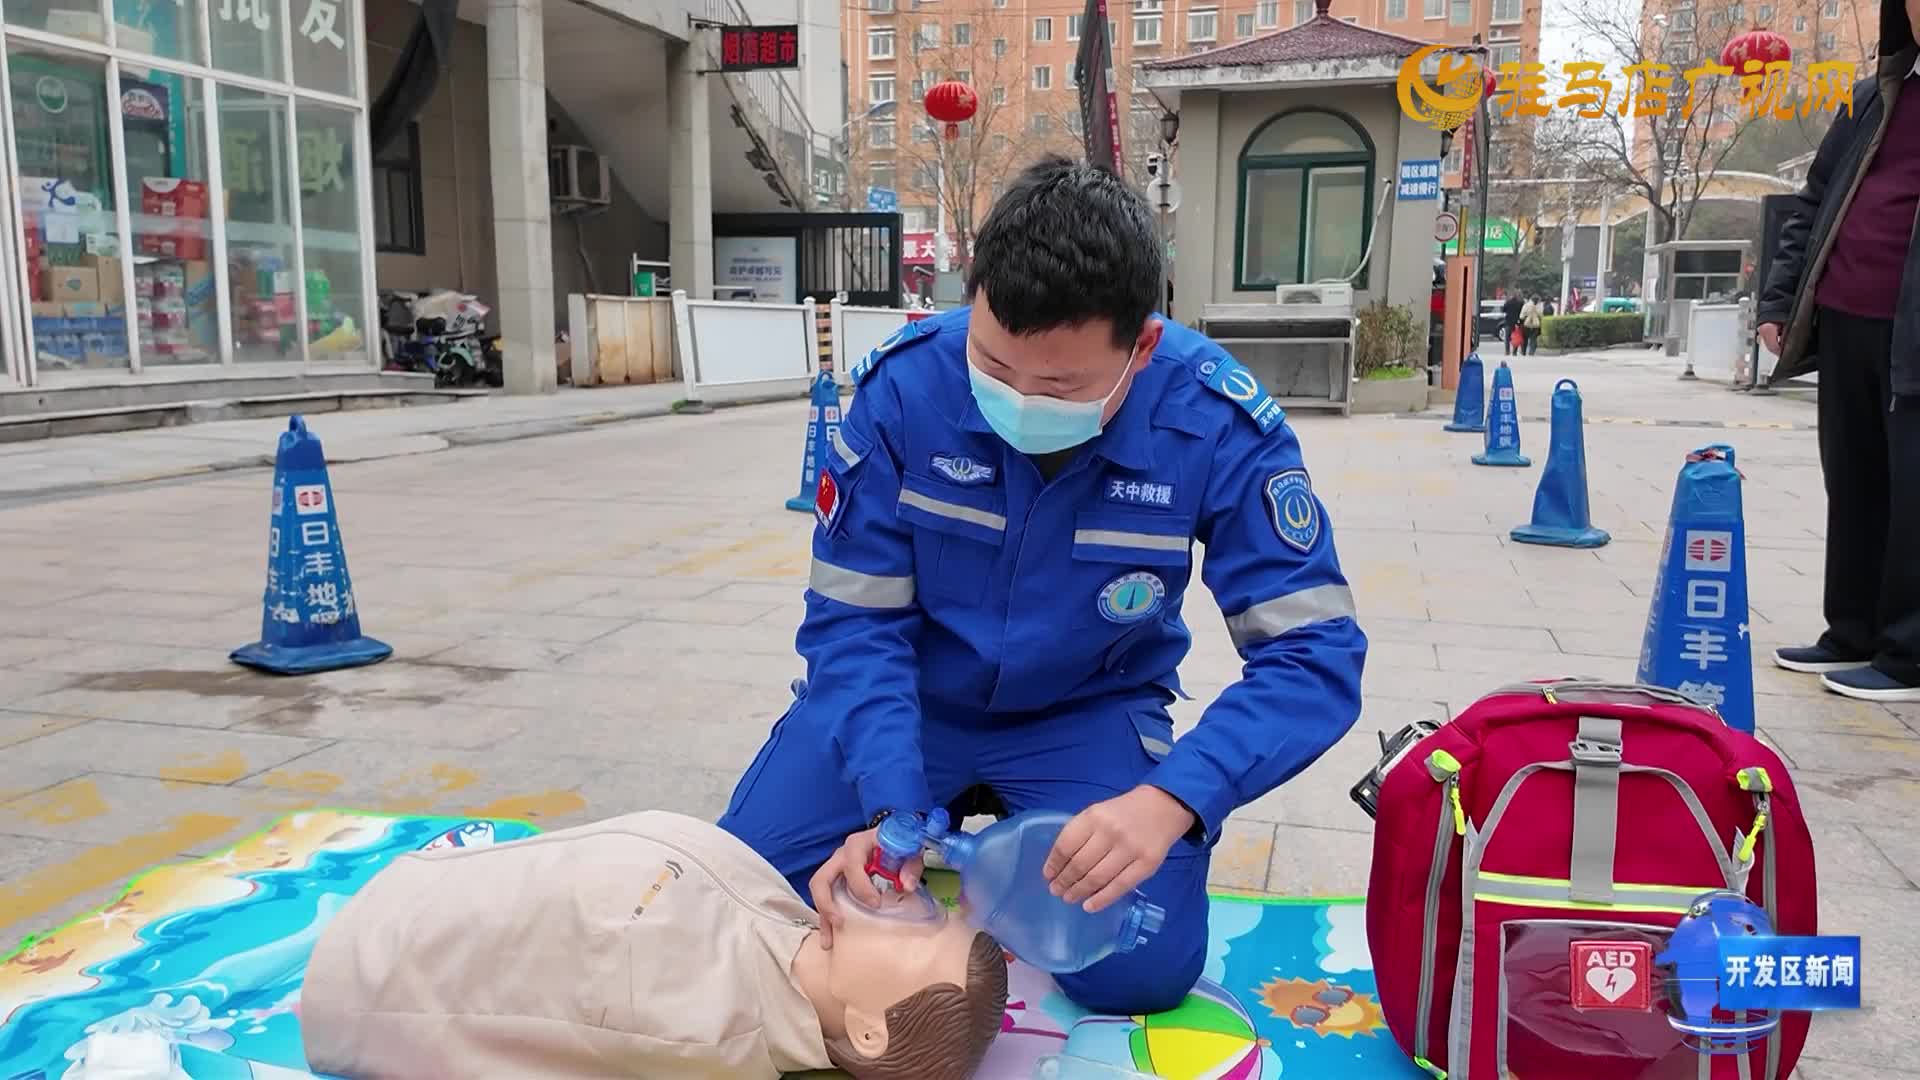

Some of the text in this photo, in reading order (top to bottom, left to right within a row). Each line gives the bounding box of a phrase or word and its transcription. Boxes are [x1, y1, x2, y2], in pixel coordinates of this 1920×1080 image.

[722, 31, 797, 66] 烟酒超市
[1110, 480, 1172, 505] 天中救援
[1586, 950, 1636, 968] AED
